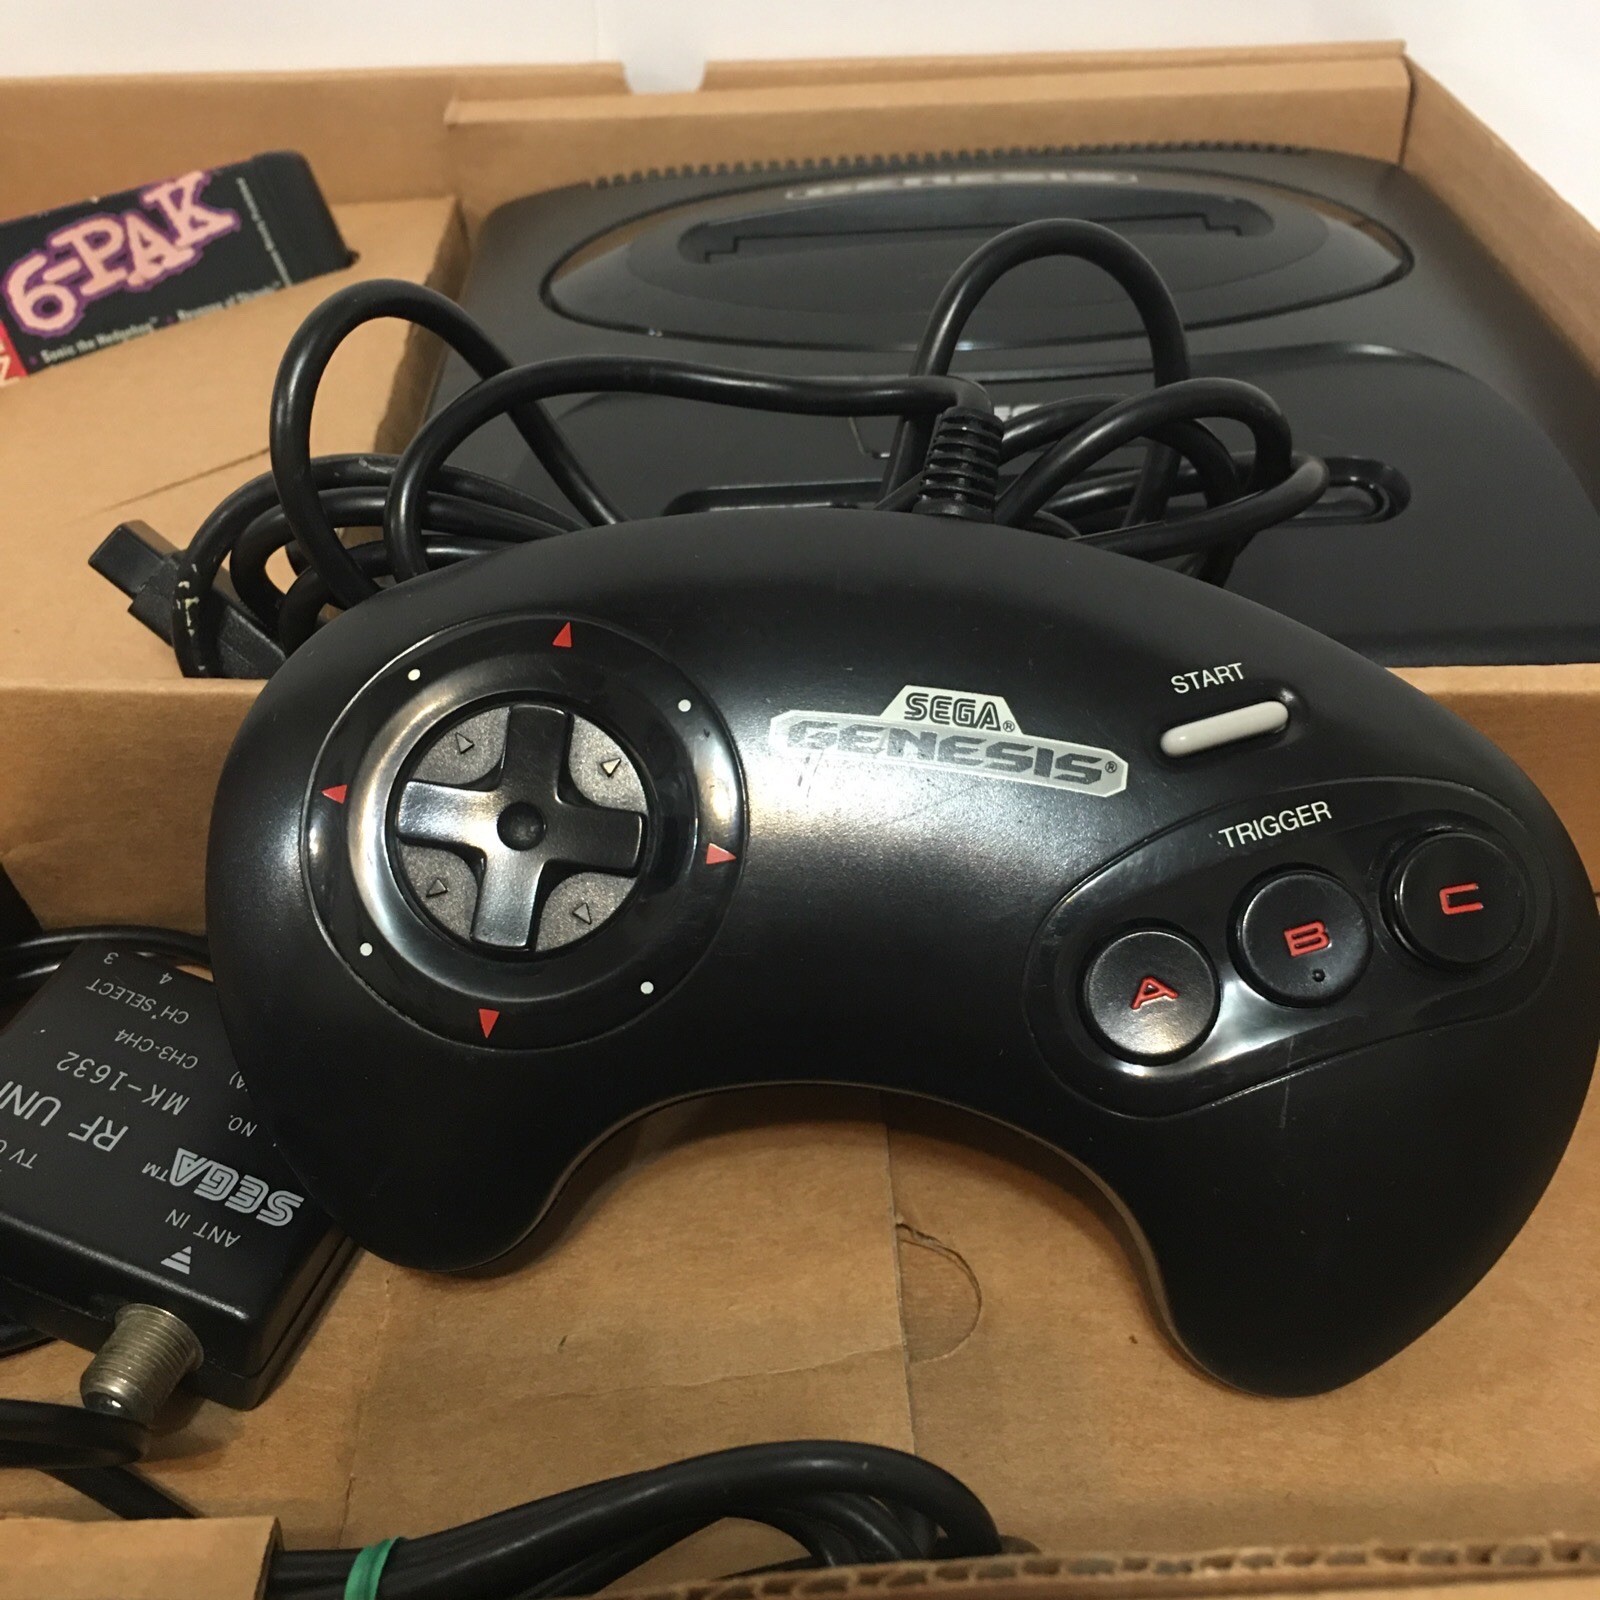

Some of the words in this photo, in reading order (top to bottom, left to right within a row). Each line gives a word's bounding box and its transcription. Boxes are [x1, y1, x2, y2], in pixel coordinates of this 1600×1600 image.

[4, 168, 238, 336] 6-PAK
[1170, 661, 1246, 695] START
[1219, 800, 1333, 850] TRIGGER
[1438, 882, 1484, 915] C
[1283, 919, 1332, 957] B
[103, 951, 119, 965] 3
[86, 978, 157, 1012] SELECT
[159, 972, 173, 985] 4
[1130, 975, 1179, 1011] A
[160, 1007, 190, 1025] CH
[114, 1028, 199, 1070] CH3-CH4
[56, 1051, 191, 1116] MK-1632
[68, 1115, 129, 1152] RF
[8, 1148, 38, 1169] TV
[169, 1147, 305, 1227] SEGA
[165, 1208, 191, 1229] IN
[192, 1220, 241, 1248] ANT
